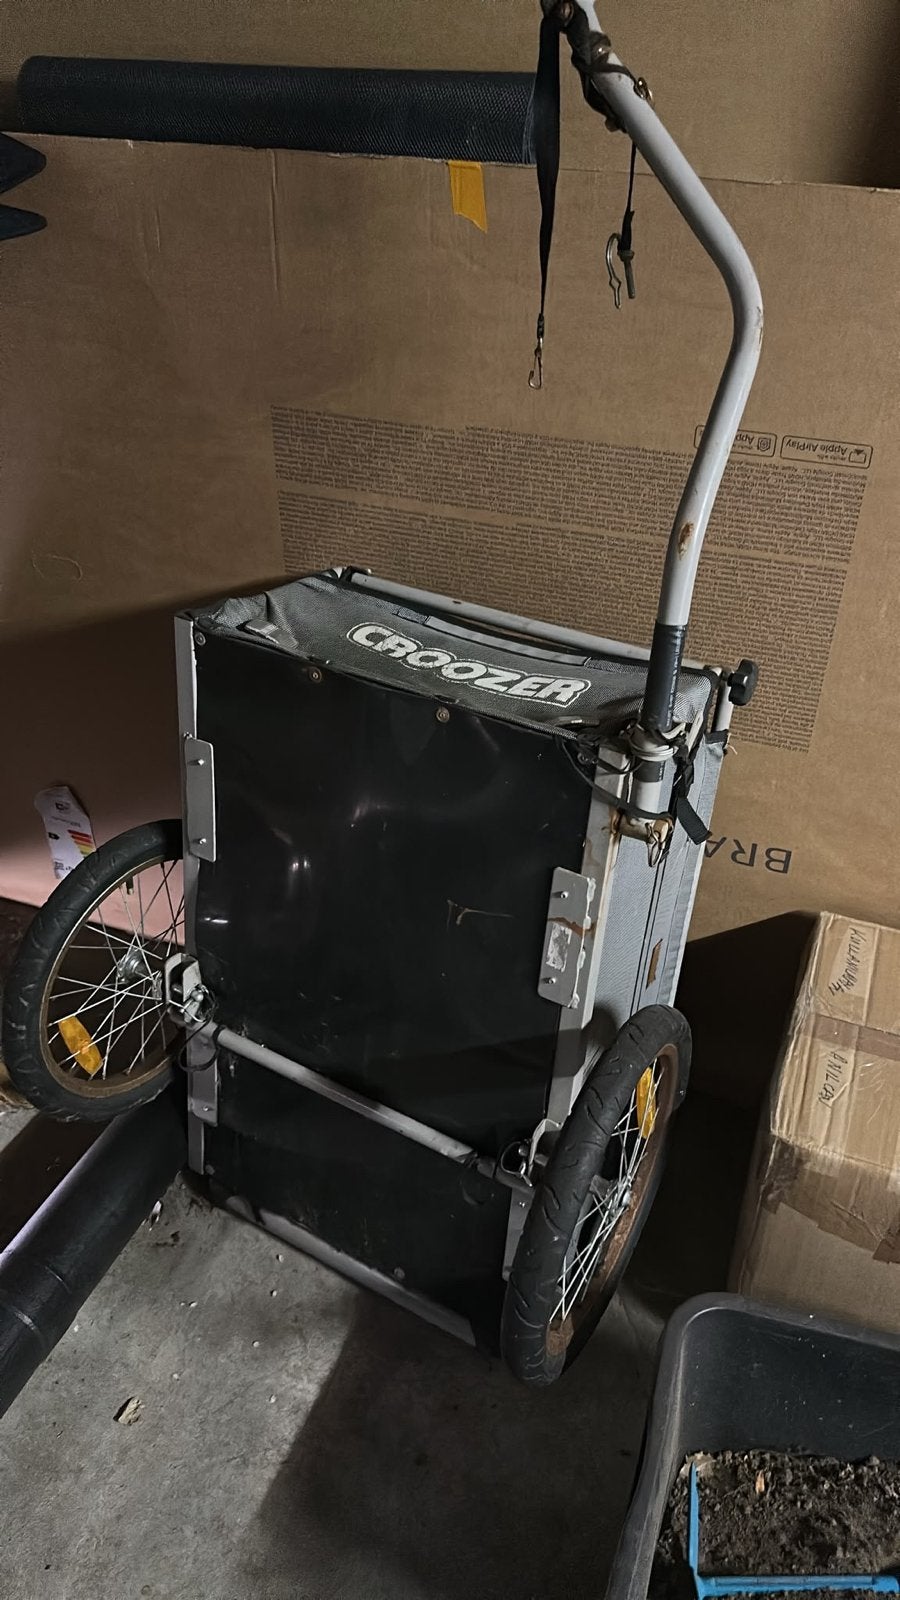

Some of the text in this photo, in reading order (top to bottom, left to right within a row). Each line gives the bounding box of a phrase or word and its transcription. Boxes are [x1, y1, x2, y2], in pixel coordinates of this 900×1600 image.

[734, 433, 754, 444] App
[784, 438, 847, 455] Apple AirPlay
[346, 622, 593, 707] CROOZER
[704, 836, 792, 874] BRA
